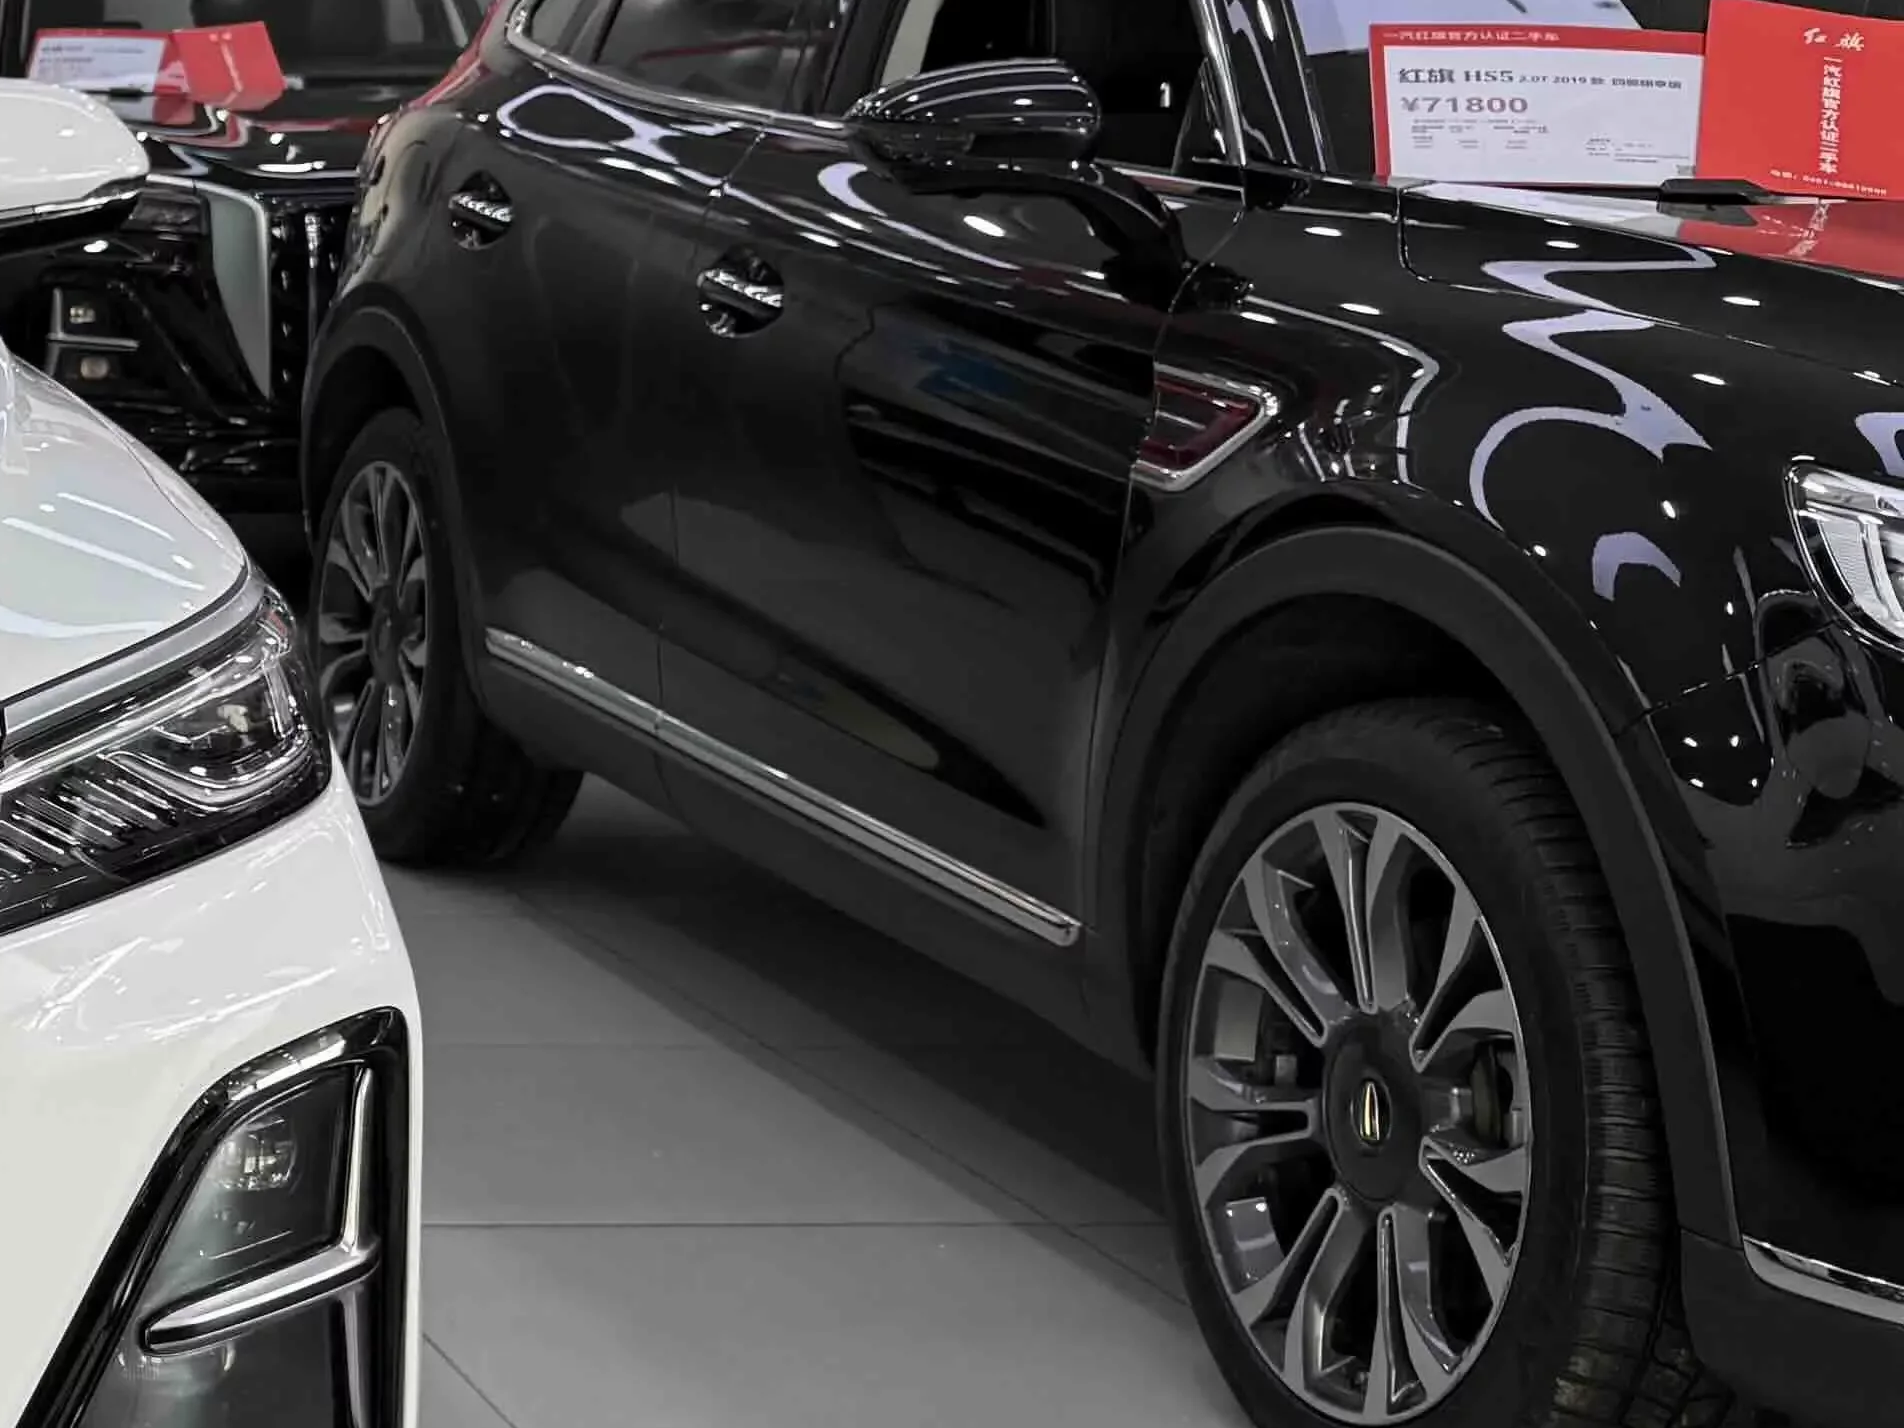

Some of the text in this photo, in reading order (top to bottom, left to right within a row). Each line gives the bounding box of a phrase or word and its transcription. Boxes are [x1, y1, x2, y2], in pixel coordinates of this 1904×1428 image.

[1399, 68, 1454, 83] 红旗
[1464, 70, 1513, 83] HS5
[1401, 96, 1528, 113] ¥71800
